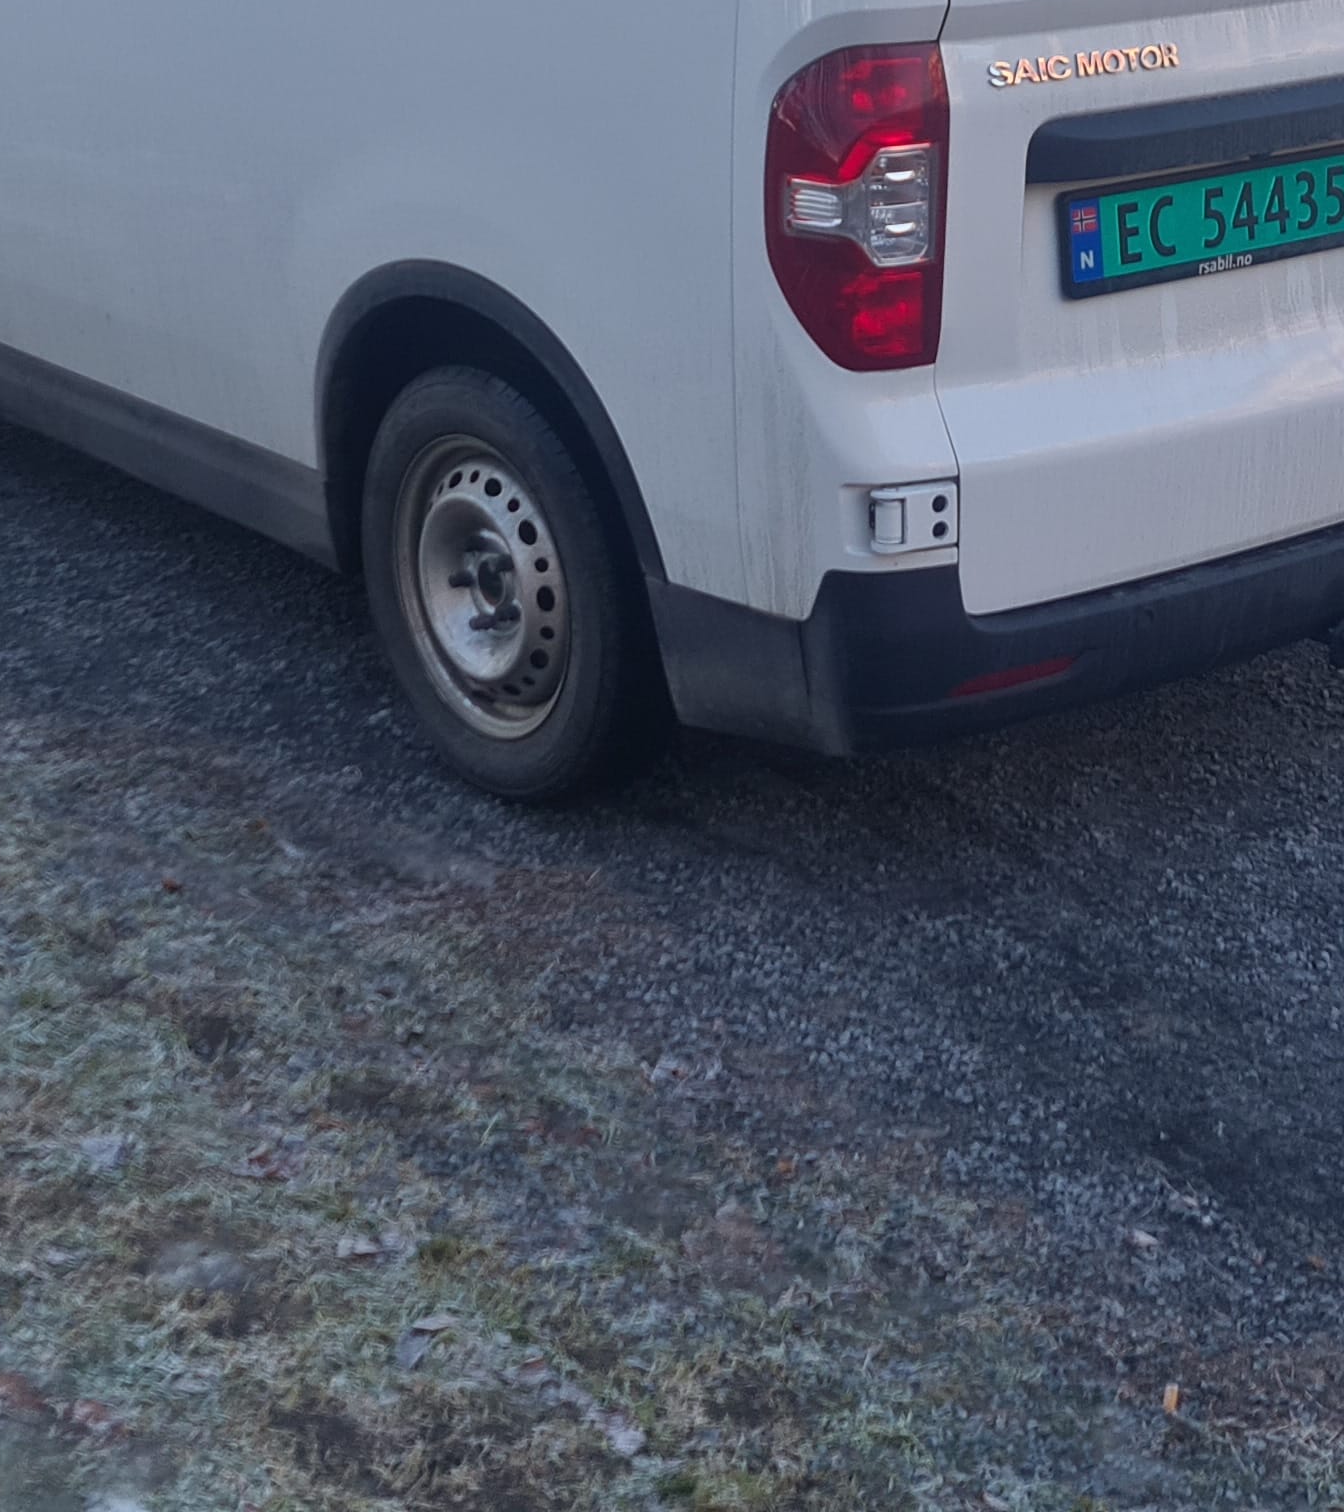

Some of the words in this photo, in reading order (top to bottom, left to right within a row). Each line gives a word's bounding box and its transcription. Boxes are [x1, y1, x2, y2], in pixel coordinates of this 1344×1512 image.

[989, 55, 1072, 88] SAIC
[1076, 42, 1180, 78] MOTOR
[1116, 195, 1177, 265] EC
[1080, 250, 1095, 270] N
[1198, 253, 1253, 275] rsabil.no
